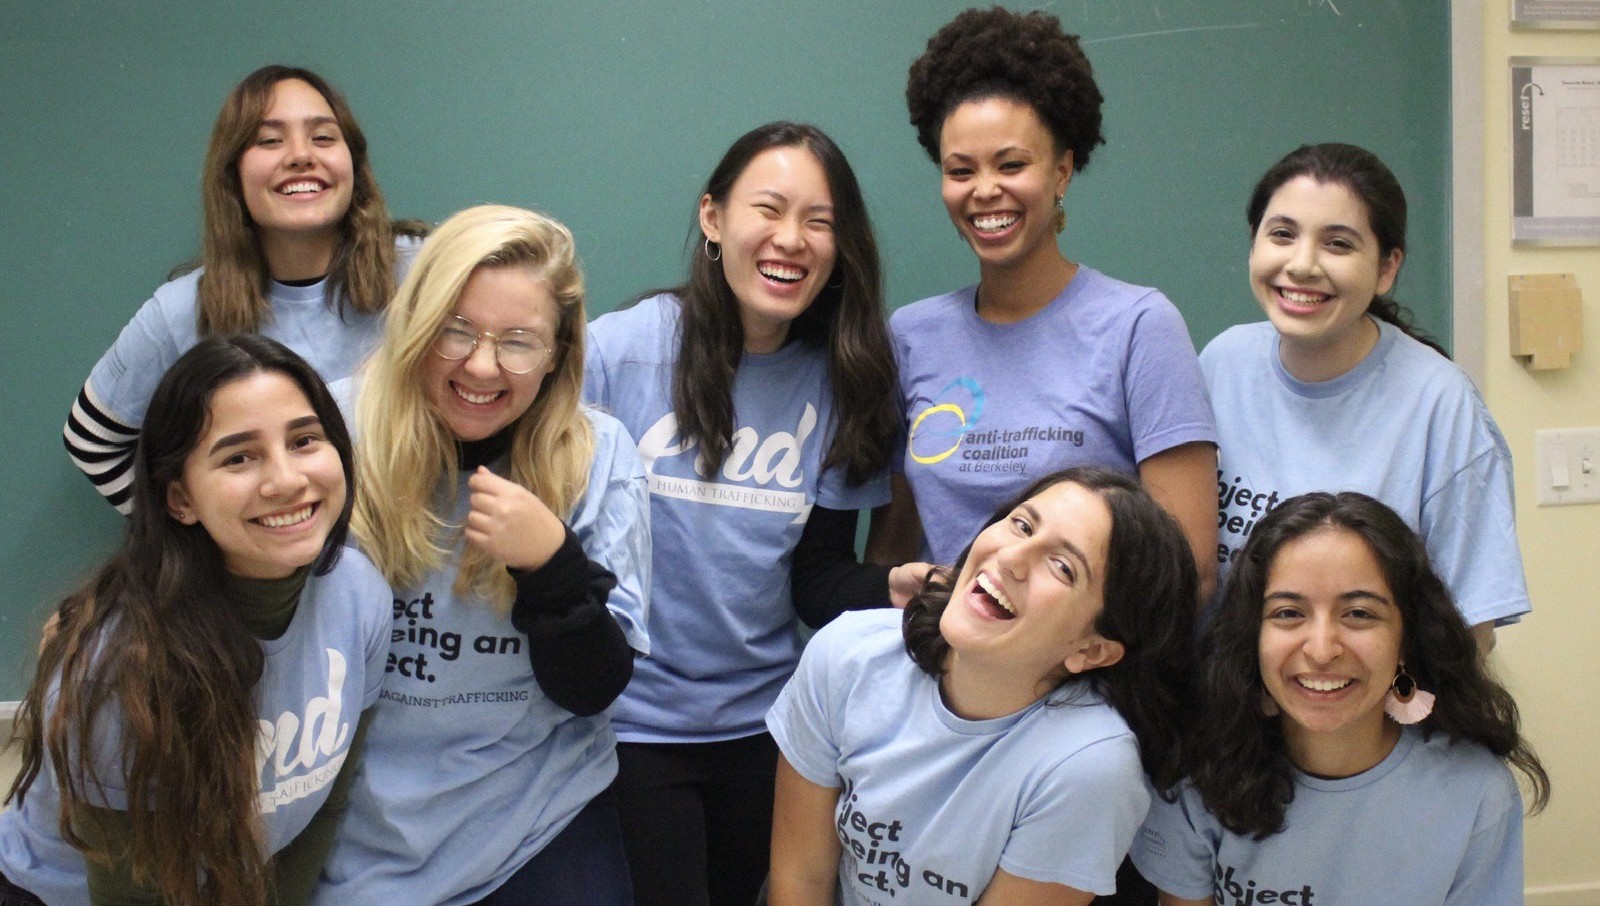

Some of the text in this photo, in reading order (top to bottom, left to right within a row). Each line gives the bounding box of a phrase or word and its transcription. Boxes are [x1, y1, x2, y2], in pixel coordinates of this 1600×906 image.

[1521, 95, 1531, 130] reset
[965, 427, 1085, 447] anti-trafficking
[962, 446, 1028, 461] coalition
[959, 461, 1027, 474] at Berkeley
[656, 480, 797, 508] HUMAN TRAFFICKING
[473, 635, 521, 654] an
[923, 870, 968, 898] an
